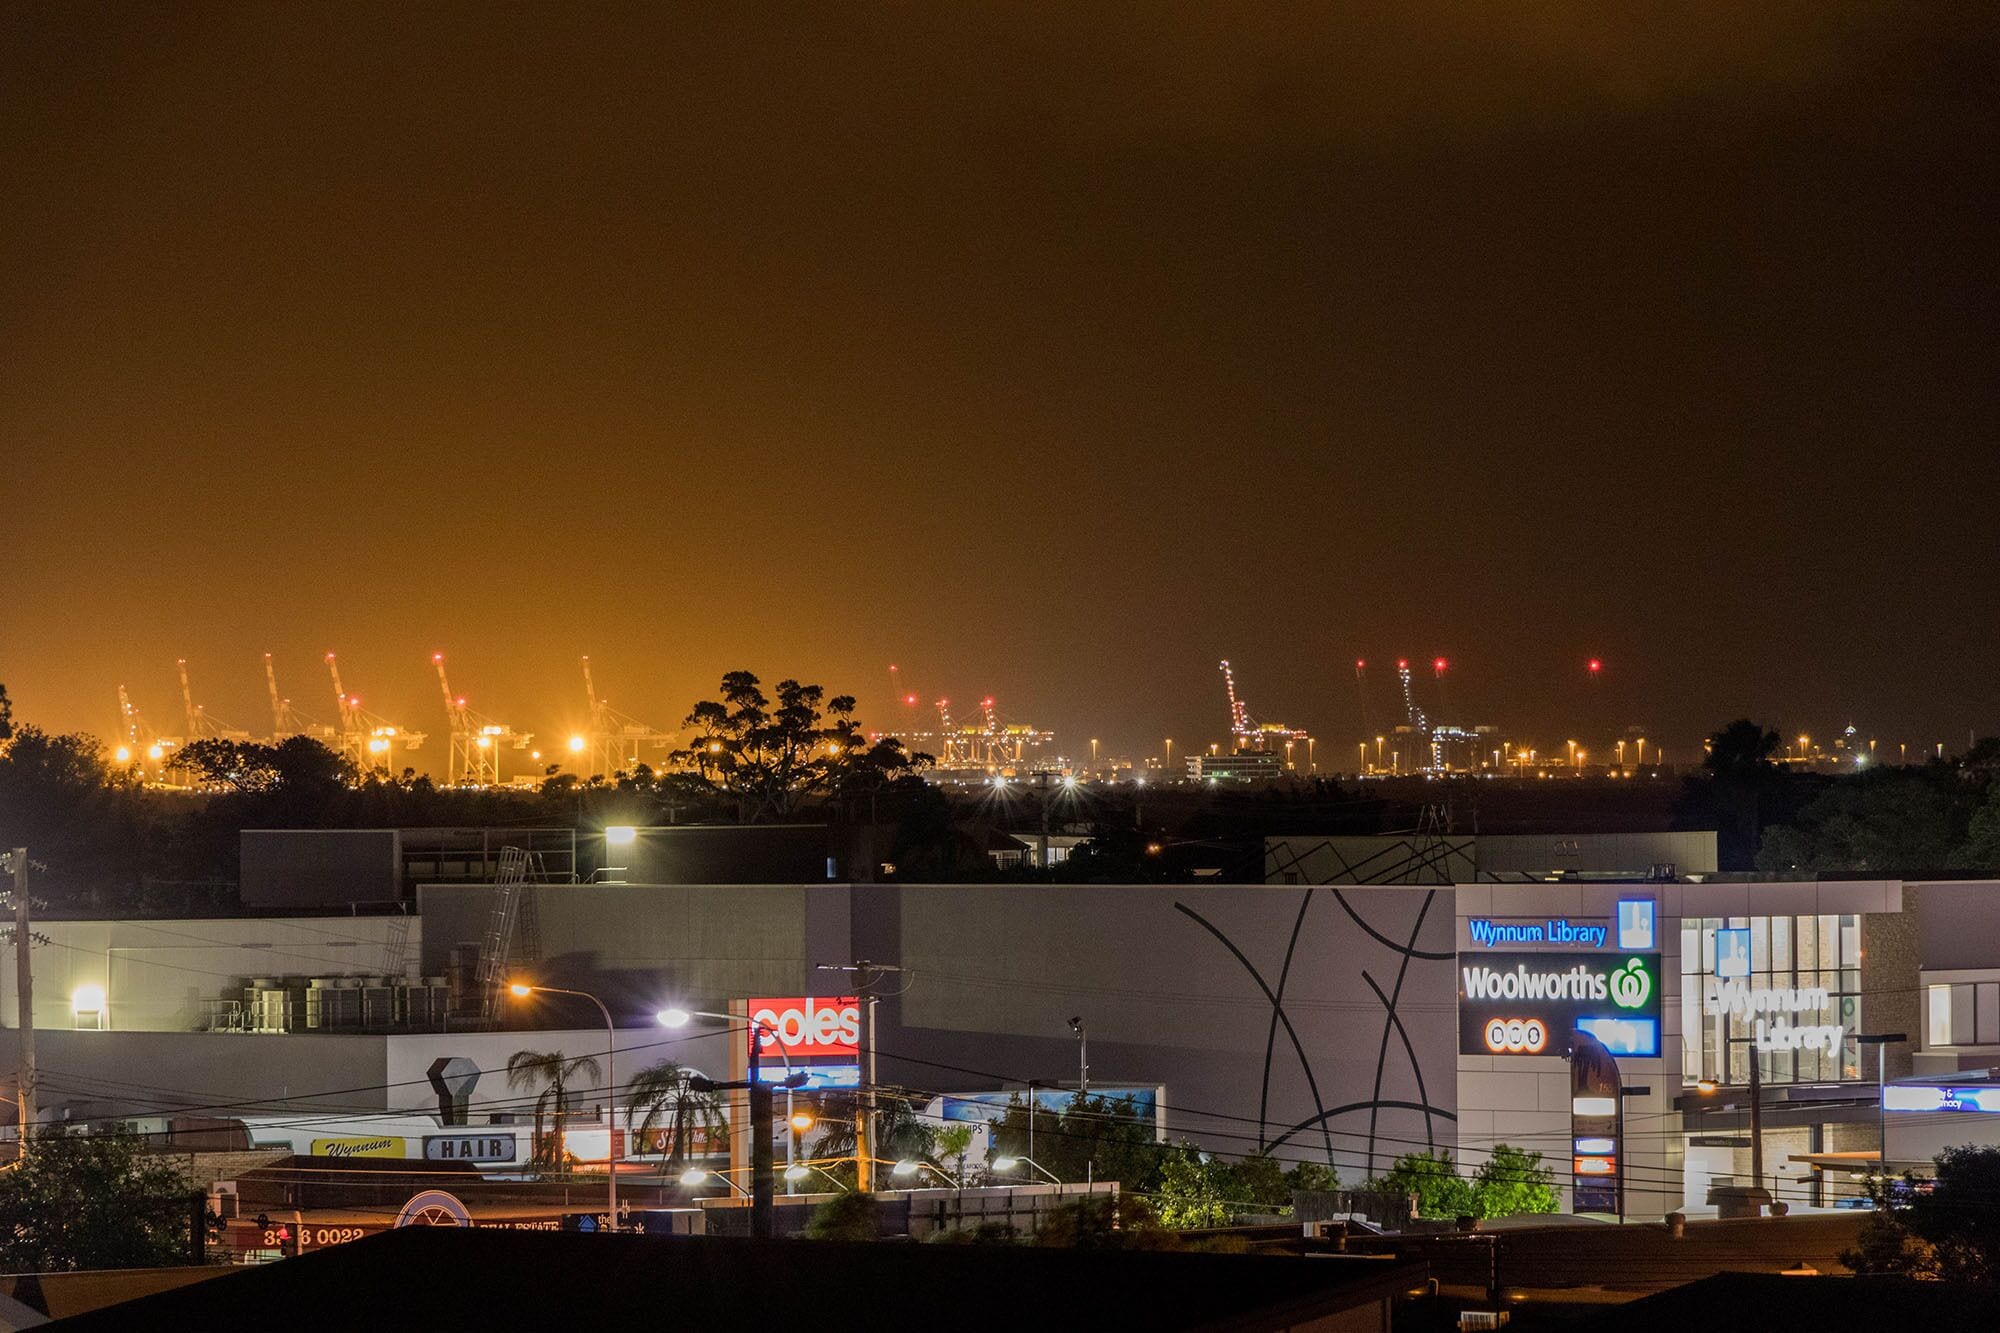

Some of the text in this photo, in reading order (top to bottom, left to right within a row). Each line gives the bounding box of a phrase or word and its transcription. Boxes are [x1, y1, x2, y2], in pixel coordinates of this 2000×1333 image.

[1469, 919, 1607, 948] Wynnum Library
[1463, 964, 1608, 1000] Woolworths
[1714, 981, 1829, 1023] Wynnum
[751, 997, 859, 1047] coles
[1756, 1016, 1844, 1058] Library
[325, 1139, 393, 1157] Wynnum
[441, 1140, 502, 1158] HAIR
[263, 1228, 364, 1246] 36 0022
